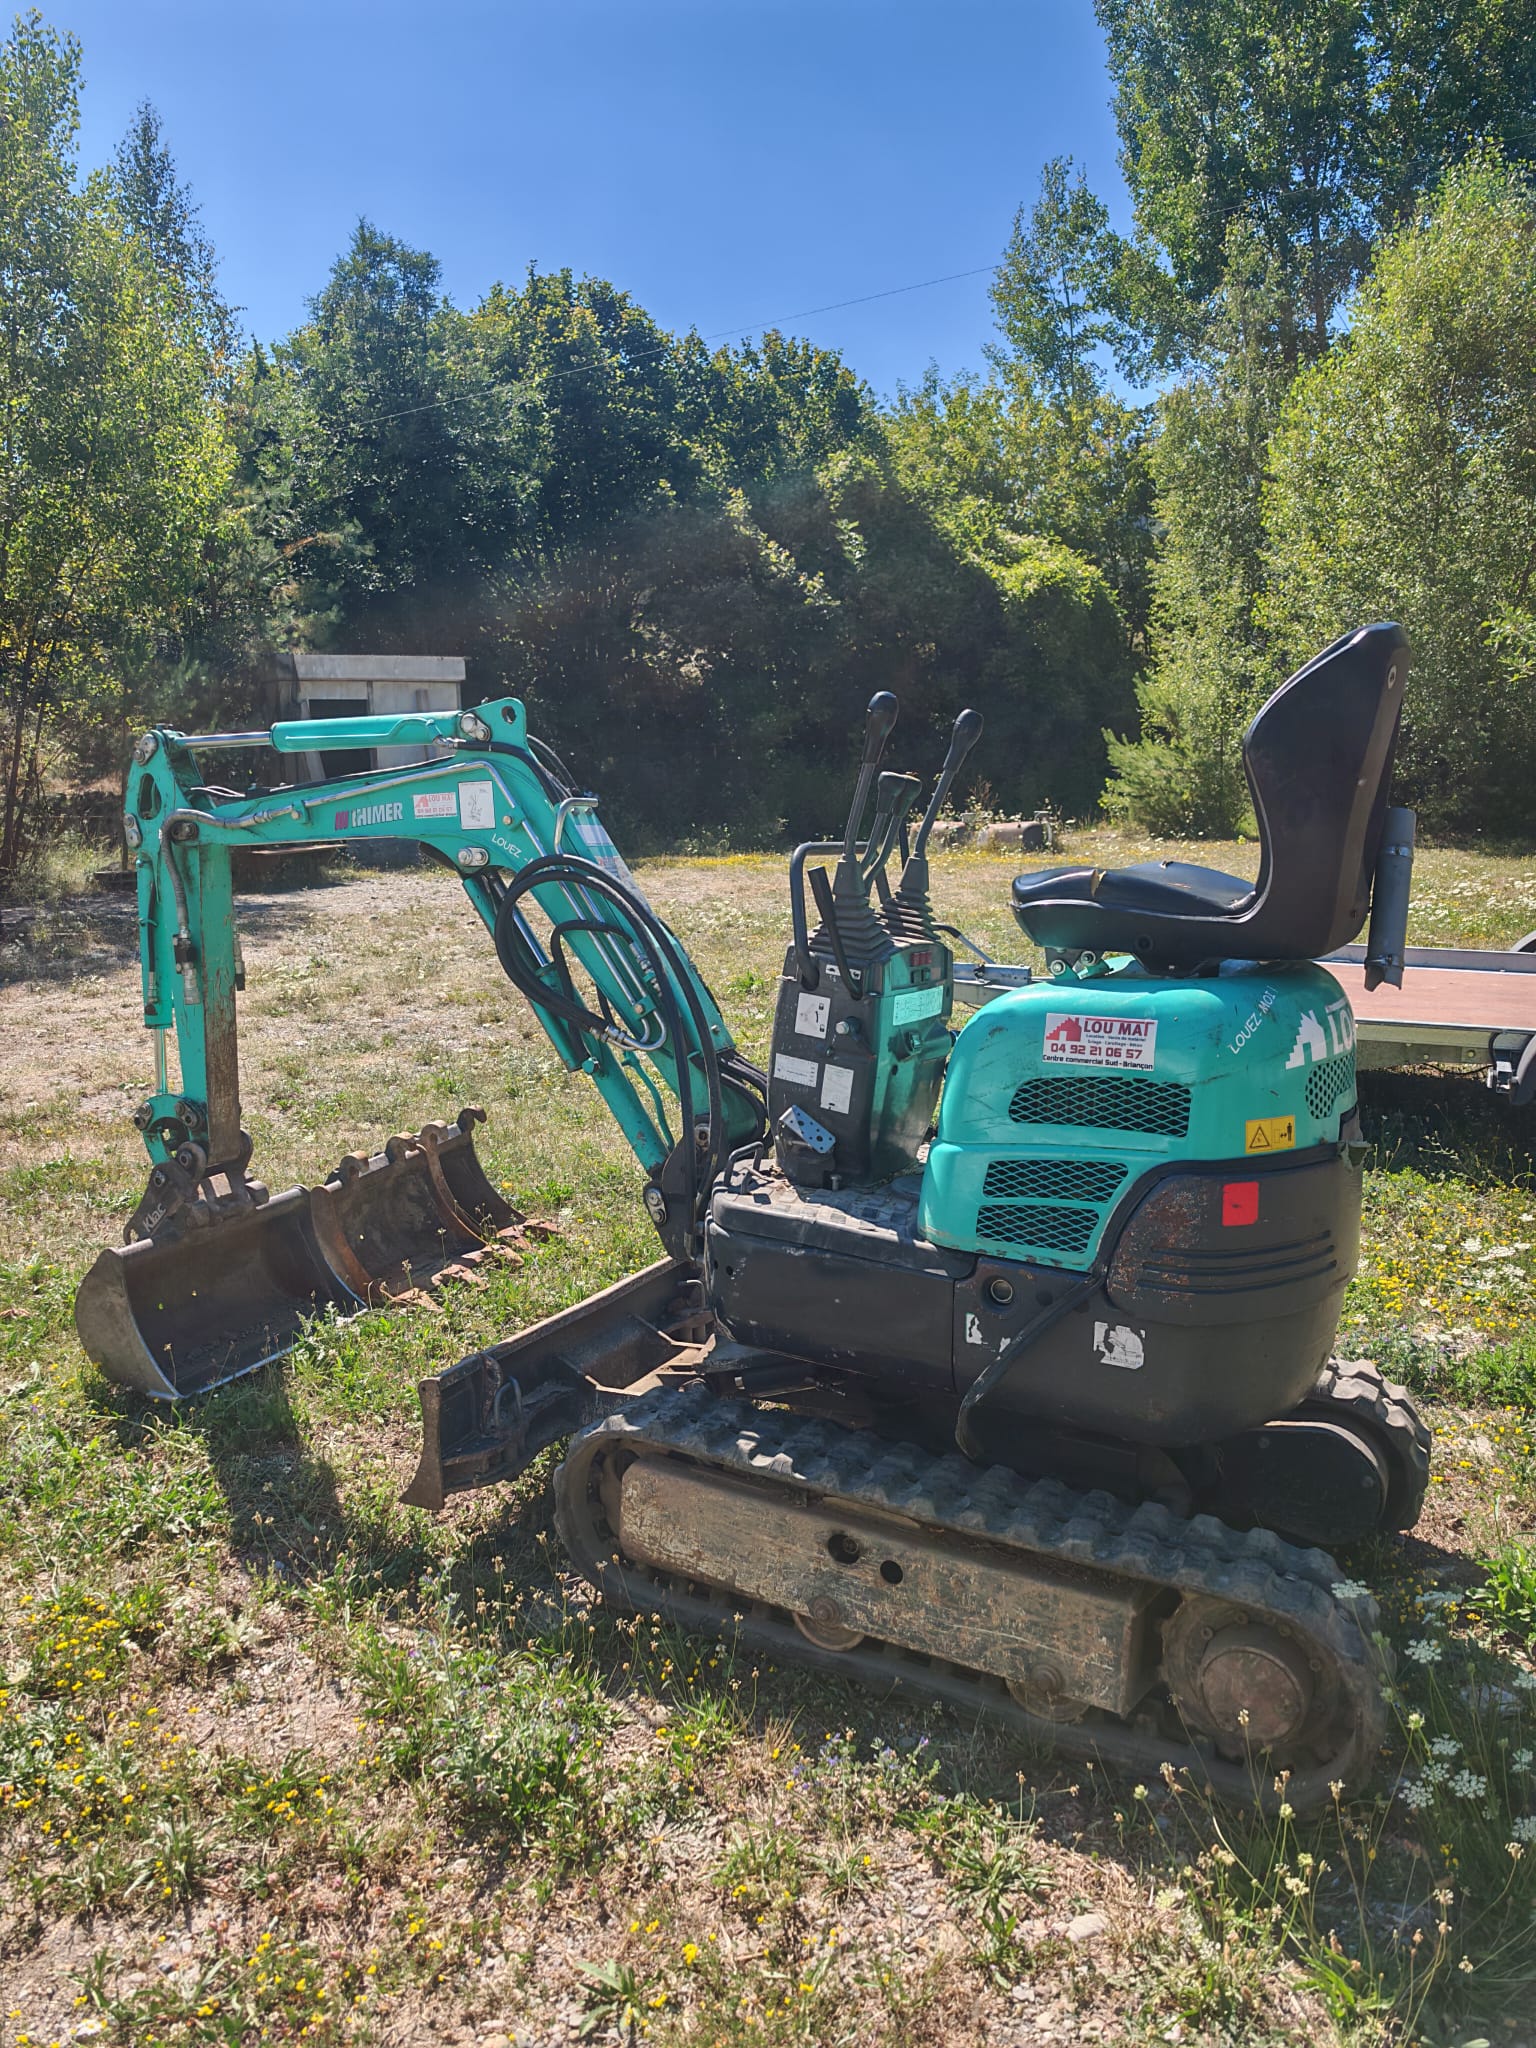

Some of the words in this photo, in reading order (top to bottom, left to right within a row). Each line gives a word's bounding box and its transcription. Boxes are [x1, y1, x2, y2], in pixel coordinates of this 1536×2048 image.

[491, 833, 522, 858] LOUEZ
[1083, 1020, 1114, 1034] LOU
[1118, 1022, 1154, 1037] MAT
[1042, 1054, 1063, 1062] Centre
[1065, 1055, 1103, 1065] commercial
[1051, 1043, 1066, 1053] 04
[1070, 1045, 1086, 1055] 92
[1090, 1046, 1102, 1056] 21
[1106, 1047, 1122, 1058] 06
[1126, 1049, 1143, 1059] 57
[142, 1203, 167, 1232] Klac
